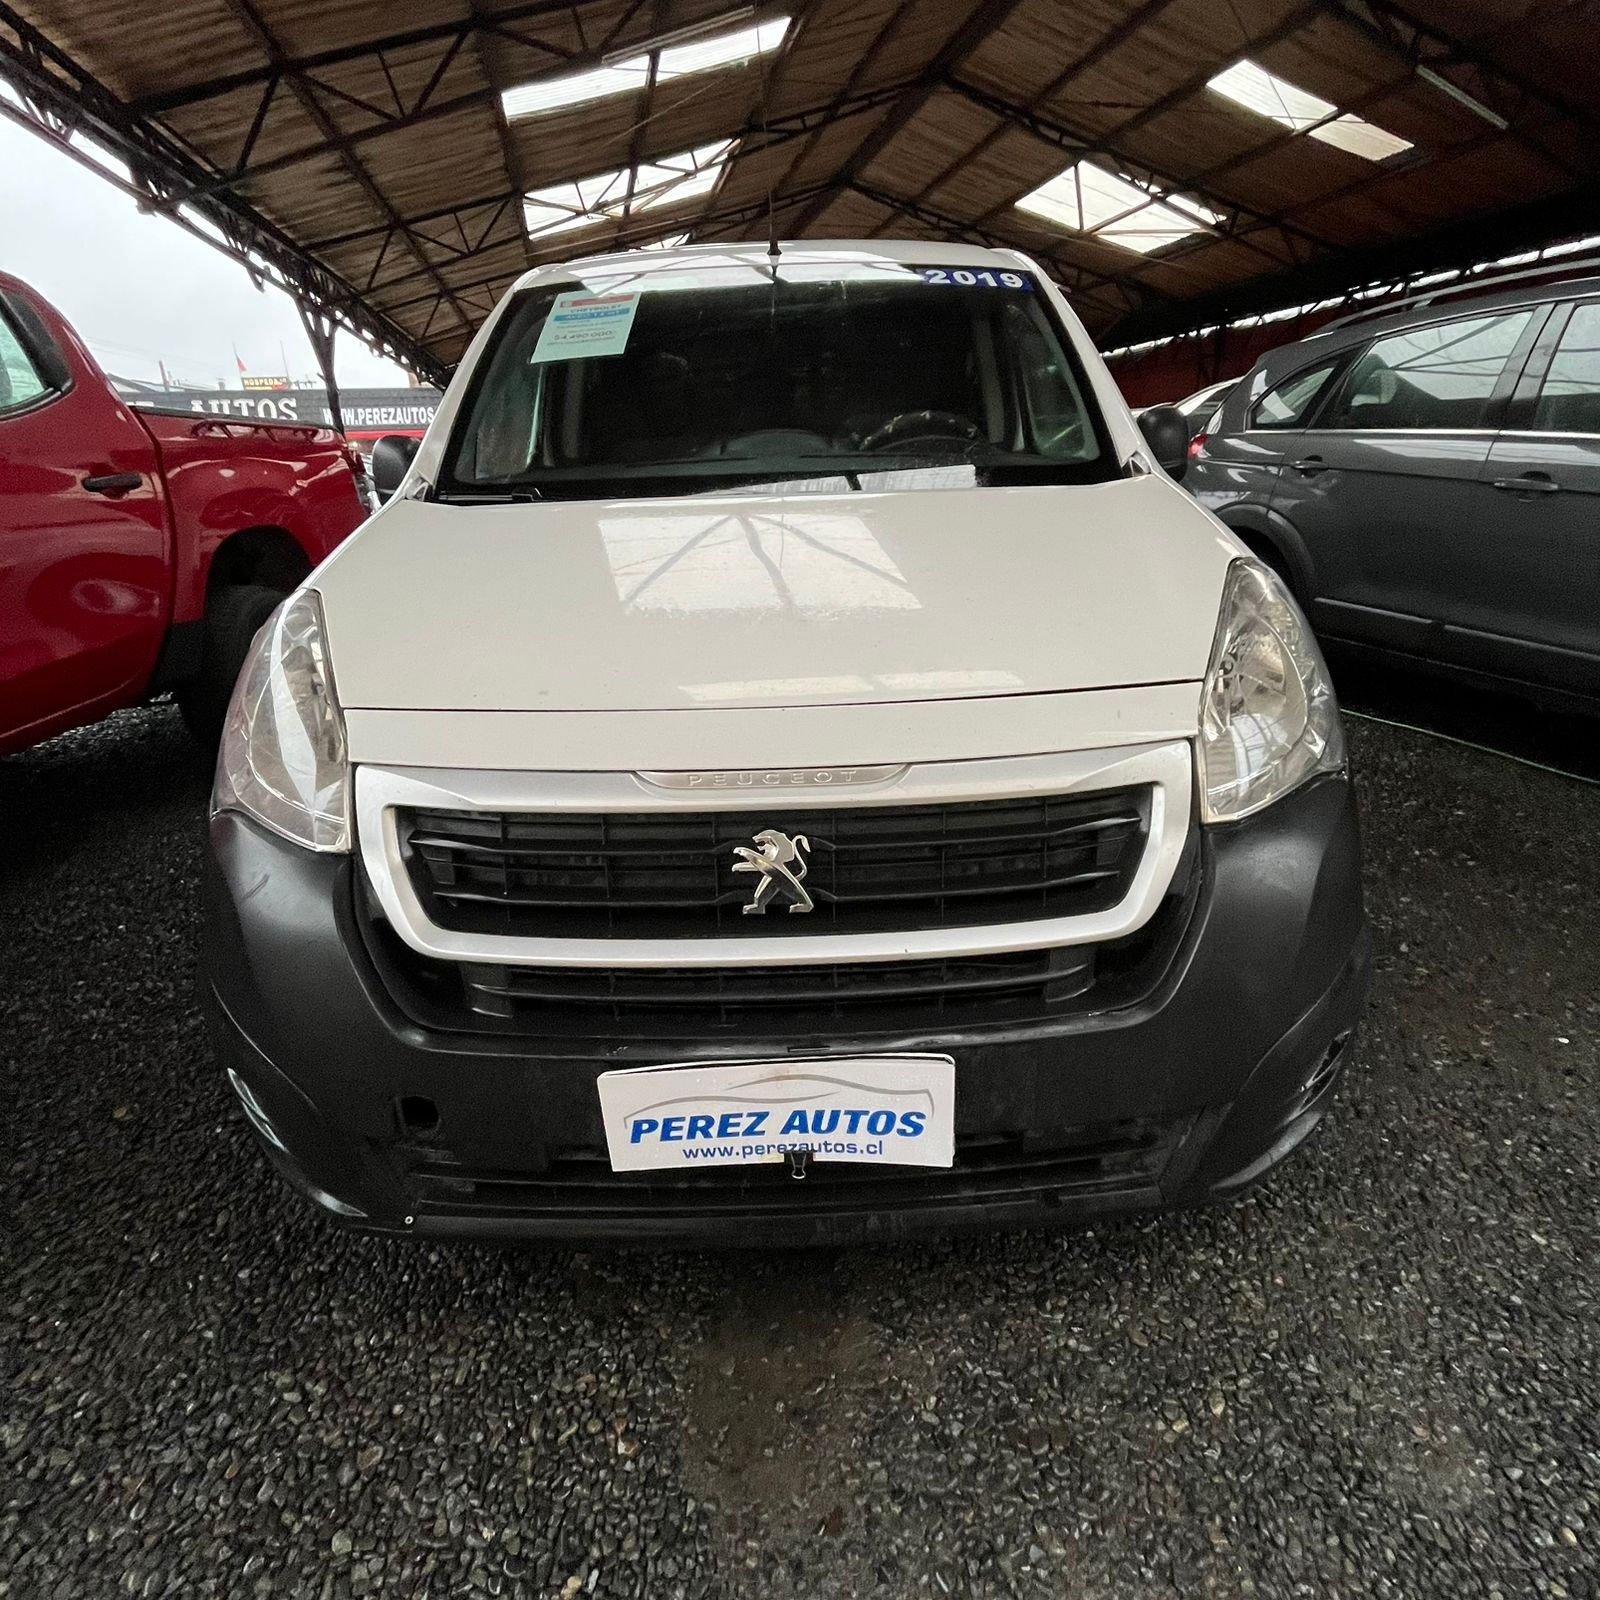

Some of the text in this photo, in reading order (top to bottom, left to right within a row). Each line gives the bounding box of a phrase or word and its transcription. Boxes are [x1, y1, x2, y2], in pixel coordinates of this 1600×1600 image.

[925, 269, 1023, 288] 2019
[323, 407, 434, 426] WW.PEREZAUTOS
[687, 770, 857, 787] PEUGEOT
[630, 1109, 926, 1143] PEREZ AUTOS
[683, 1140, 883, 1160] www.perezautos.cl
